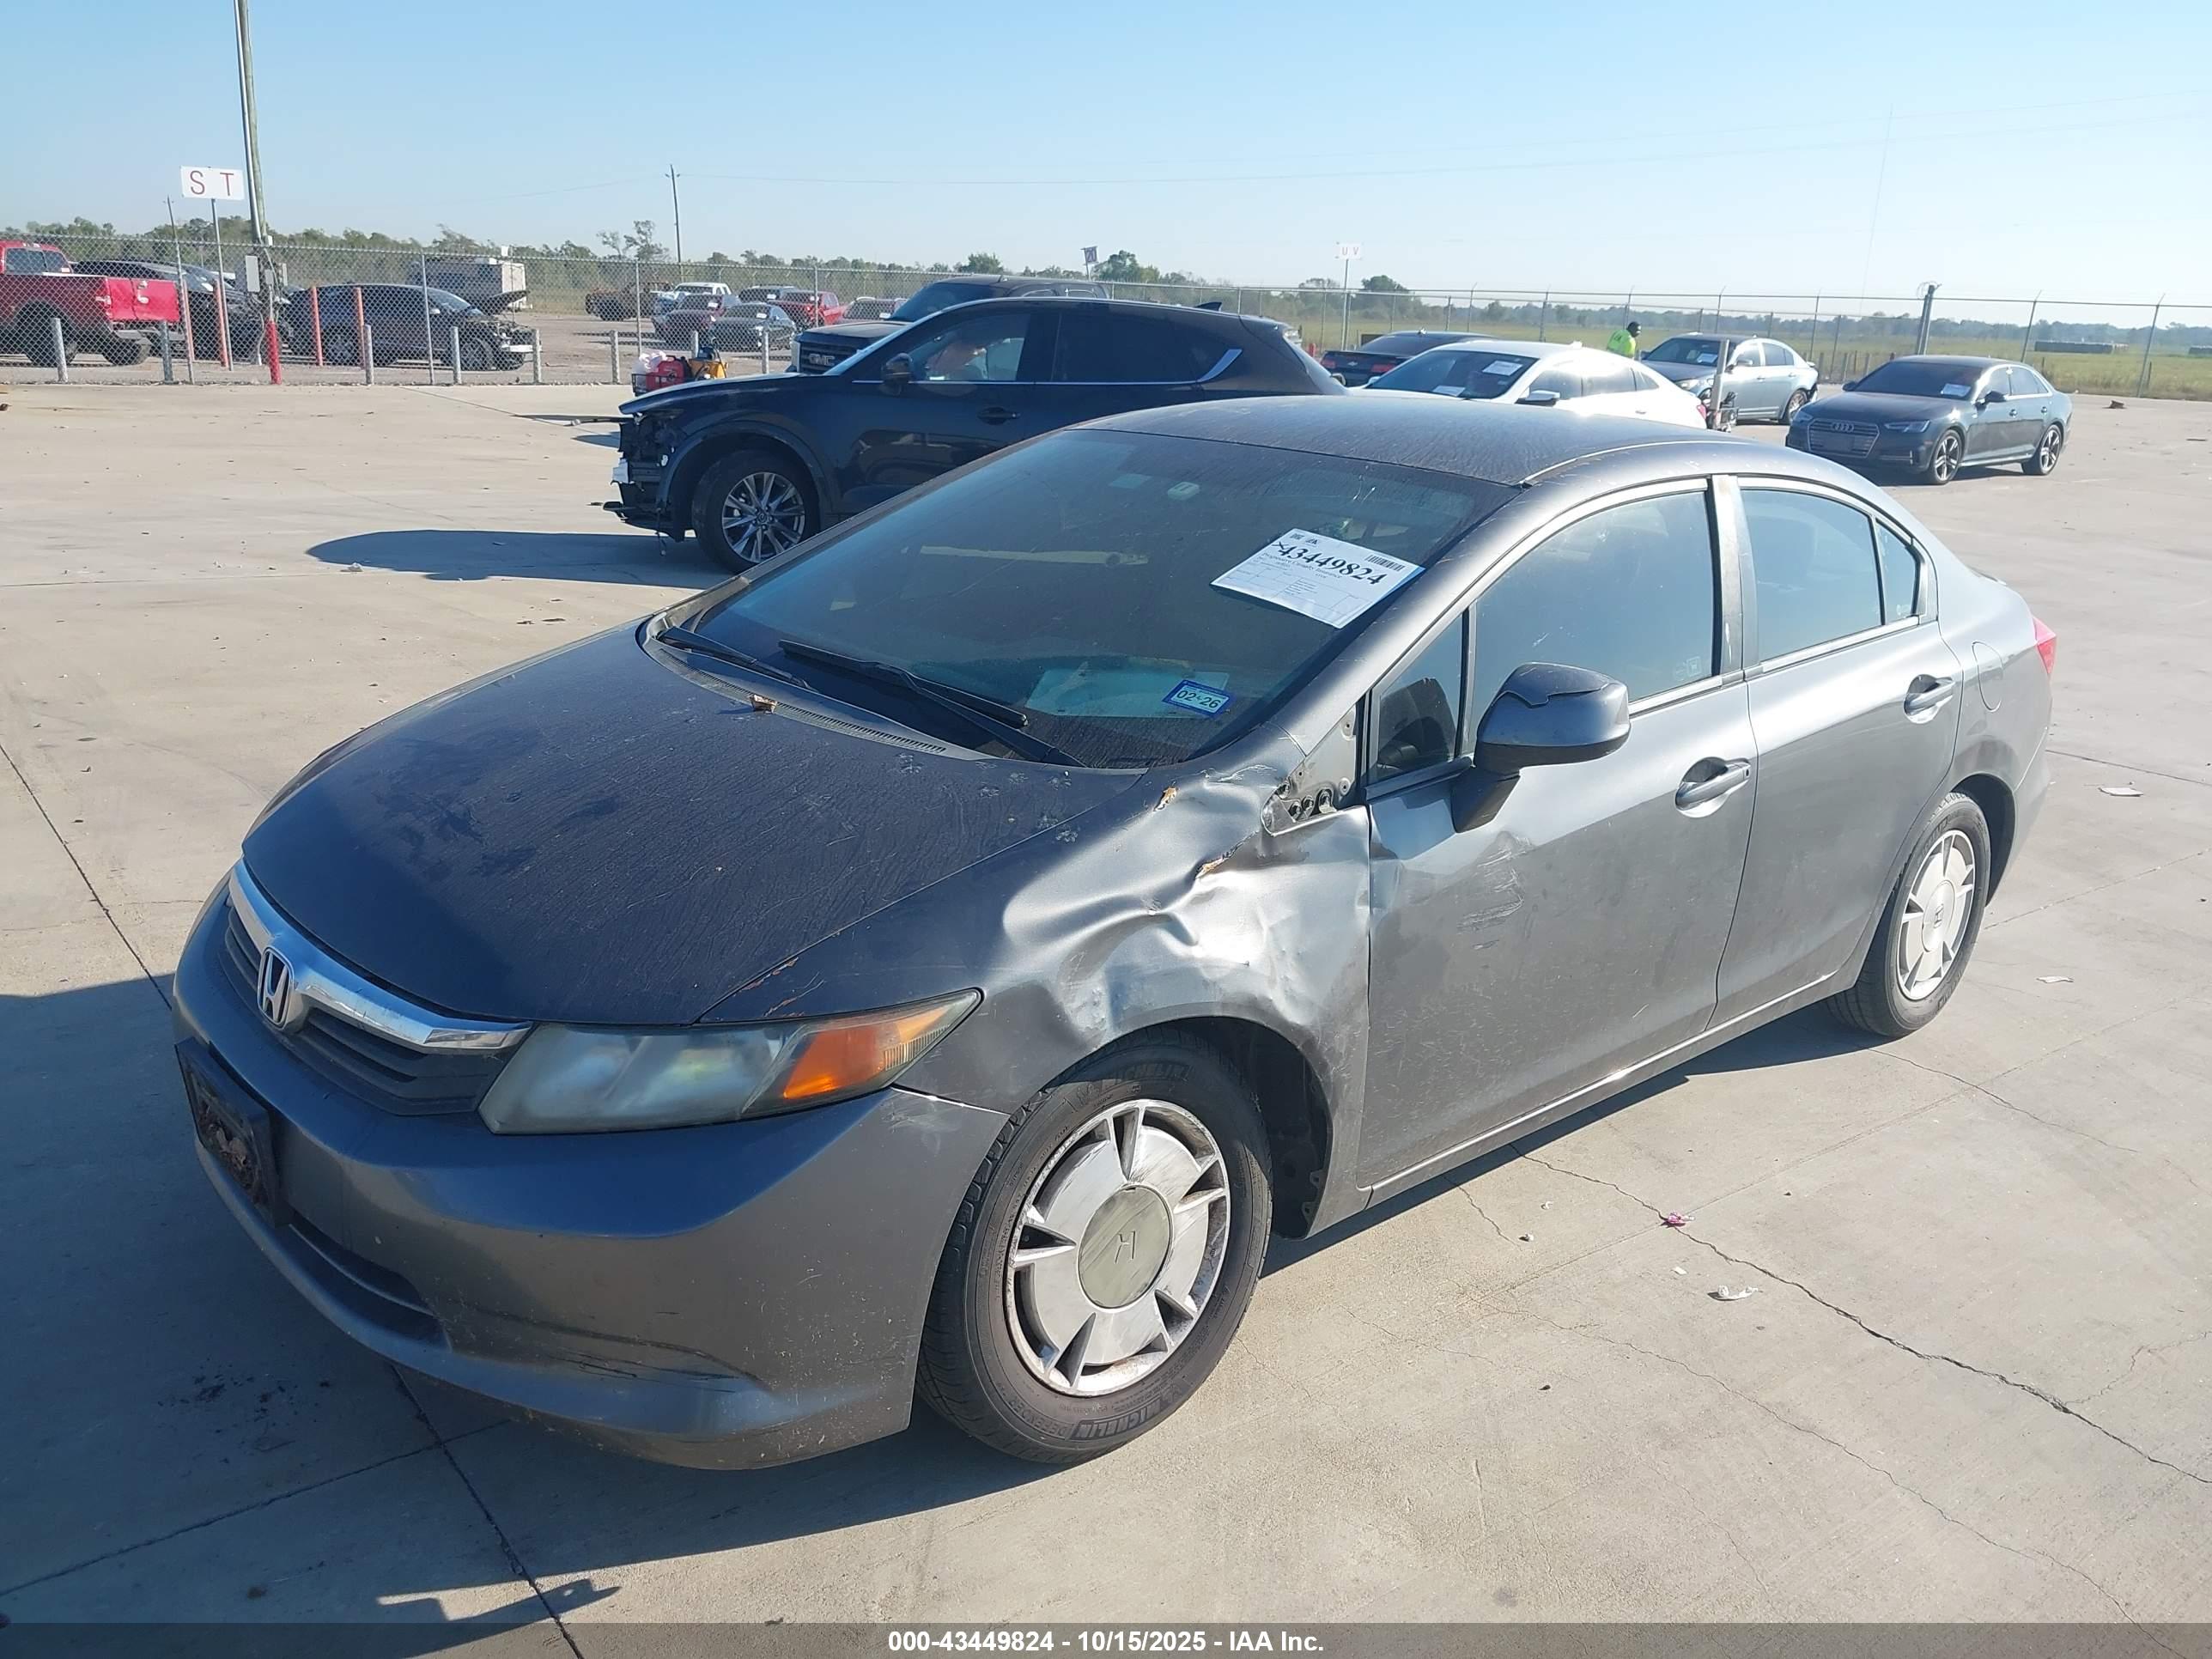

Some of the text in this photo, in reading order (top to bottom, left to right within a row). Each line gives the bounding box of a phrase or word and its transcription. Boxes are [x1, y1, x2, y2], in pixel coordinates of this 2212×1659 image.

[190, 170, 234, 197] S T
[1342, 246, 1359, 256] U V
[809, 353, 835, 367] GMC
